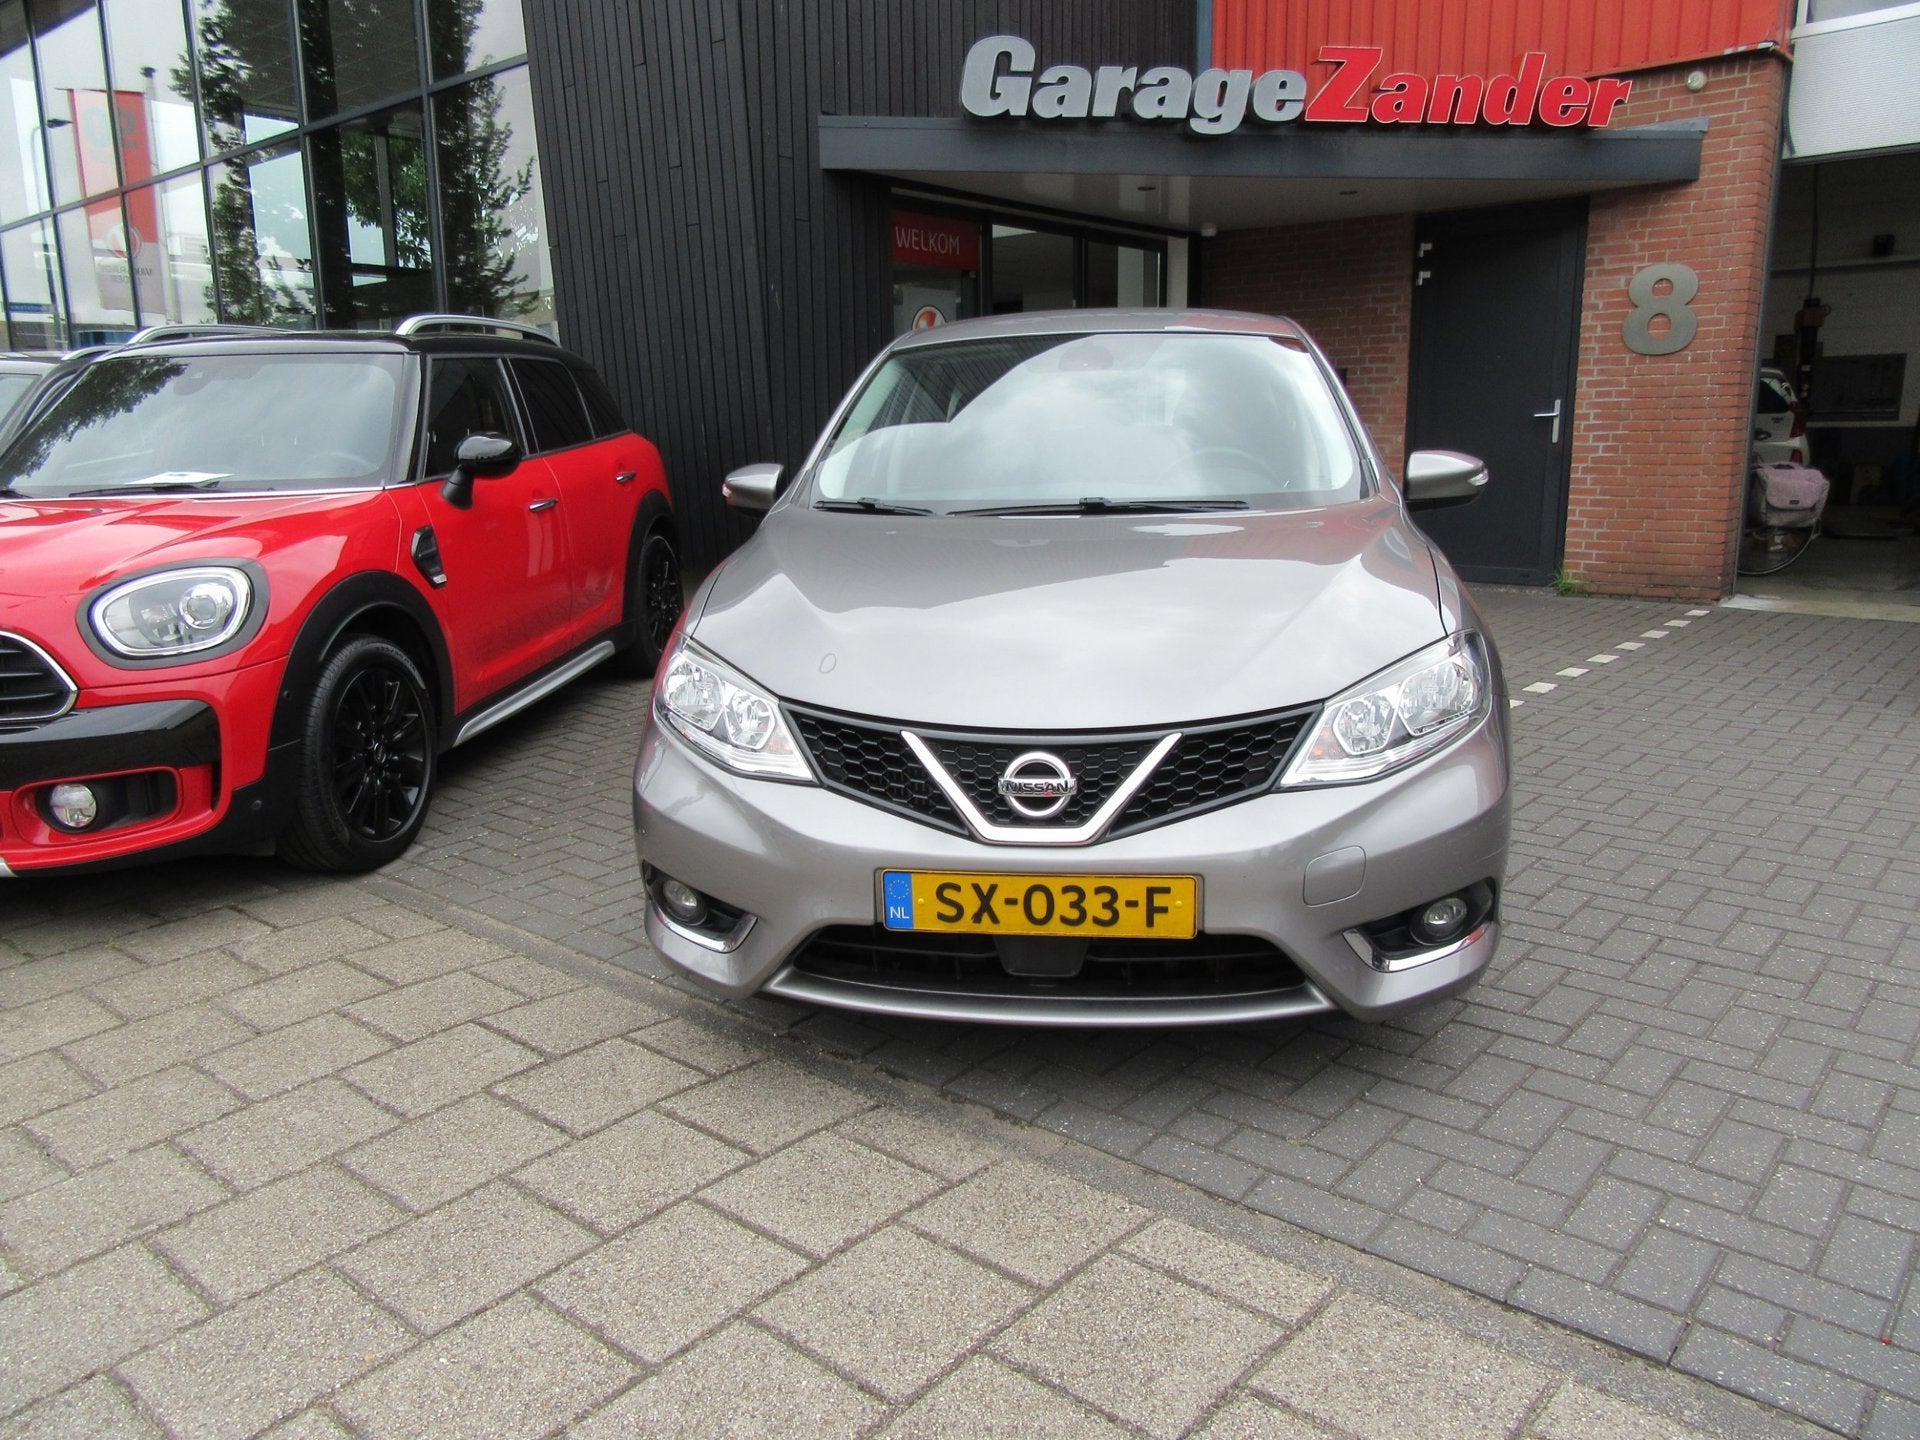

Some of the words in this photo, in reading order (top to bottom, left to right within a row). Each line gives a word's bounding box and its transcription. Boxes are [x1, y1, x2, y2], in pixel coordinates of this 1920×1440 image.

[895, 225, 960, 256] WELKOM
[1622, 263, 1699, 355] 8
[1002, 781, 1069, 793] NISSAN
[889, 906, 910, 920] NL
[935, 882, 1171, 928] SX-033-F
